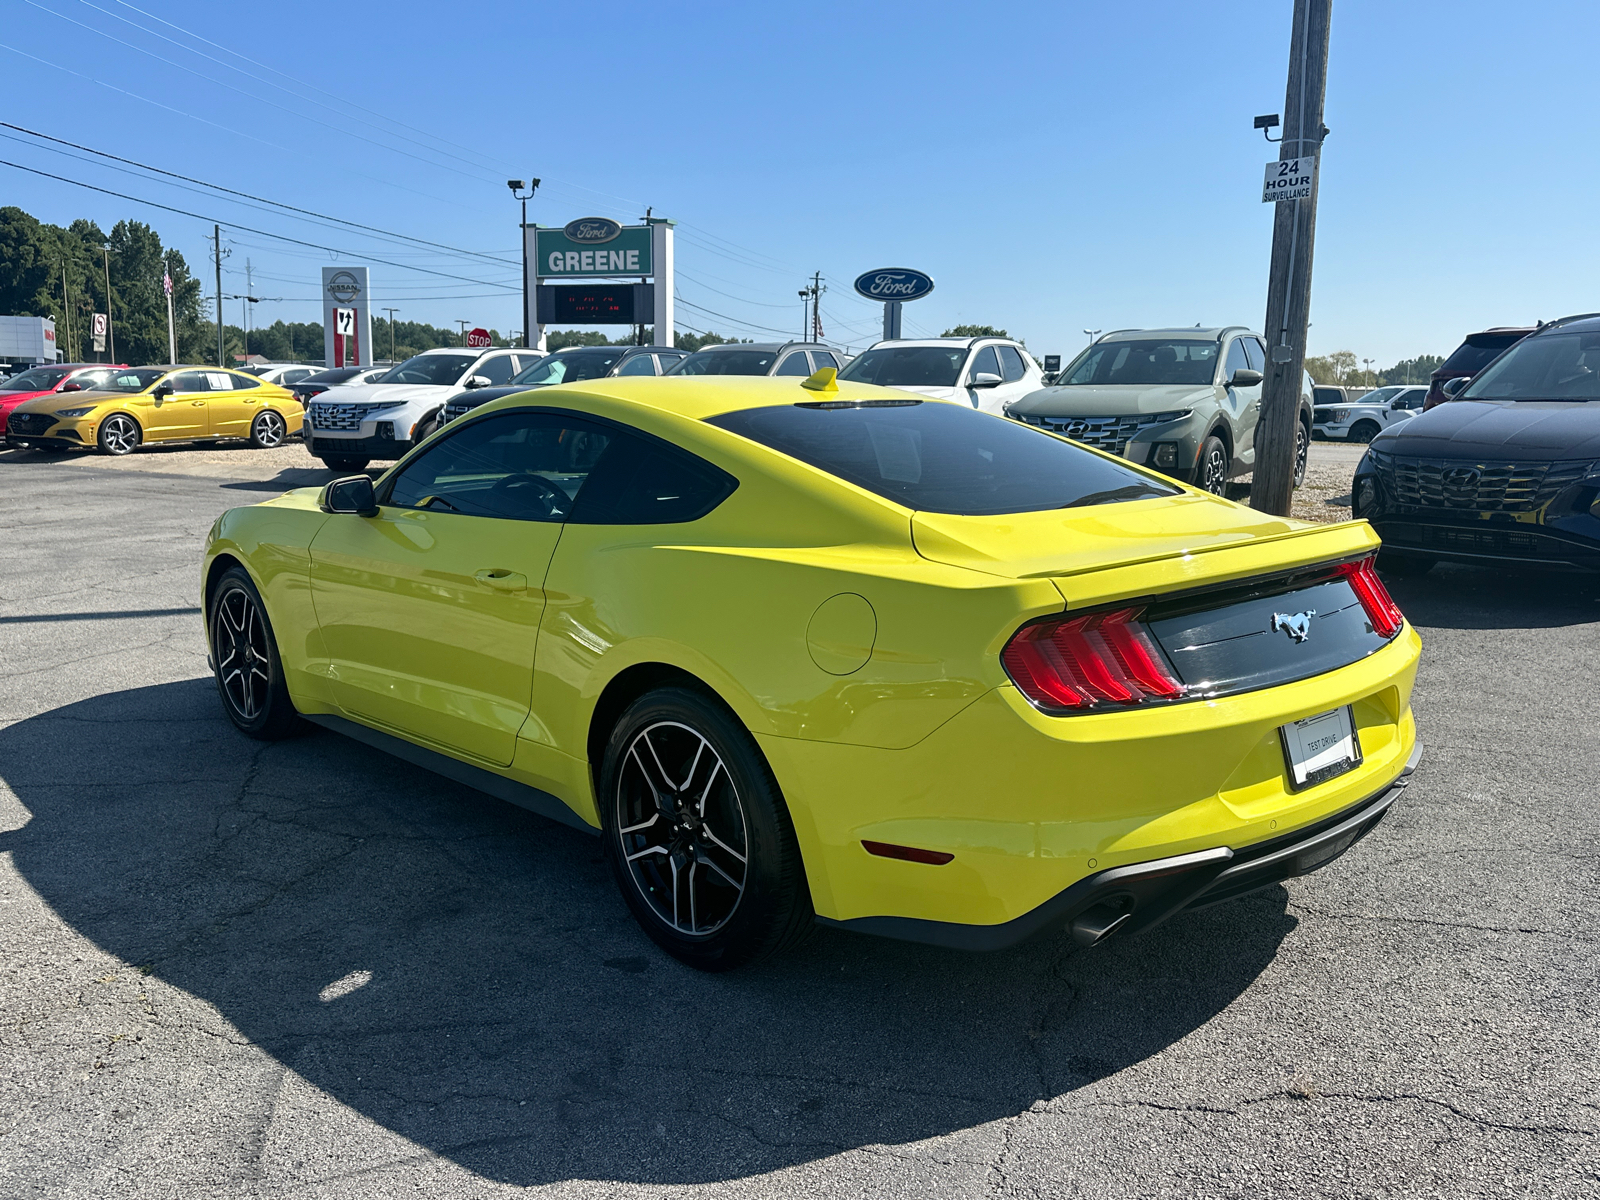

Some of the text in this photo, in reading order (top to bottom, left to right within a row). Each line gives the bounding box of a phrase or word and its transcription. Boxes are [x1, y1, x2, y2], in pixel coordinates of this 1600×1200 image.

[1278, 160, 1299, 176] 24
[1266, 176, 1310, 189] HOUR
[1264, 187, 1310, 202] SURVEILLANCE
[577, 223, 607, 239] Ford
[548, 249, 640, 272] GREENE
[870, 274, 917, 294] Ford
[468, 334, 491, 347] STOP
[1307, 733, 1338, 752] TEST DRIVE
